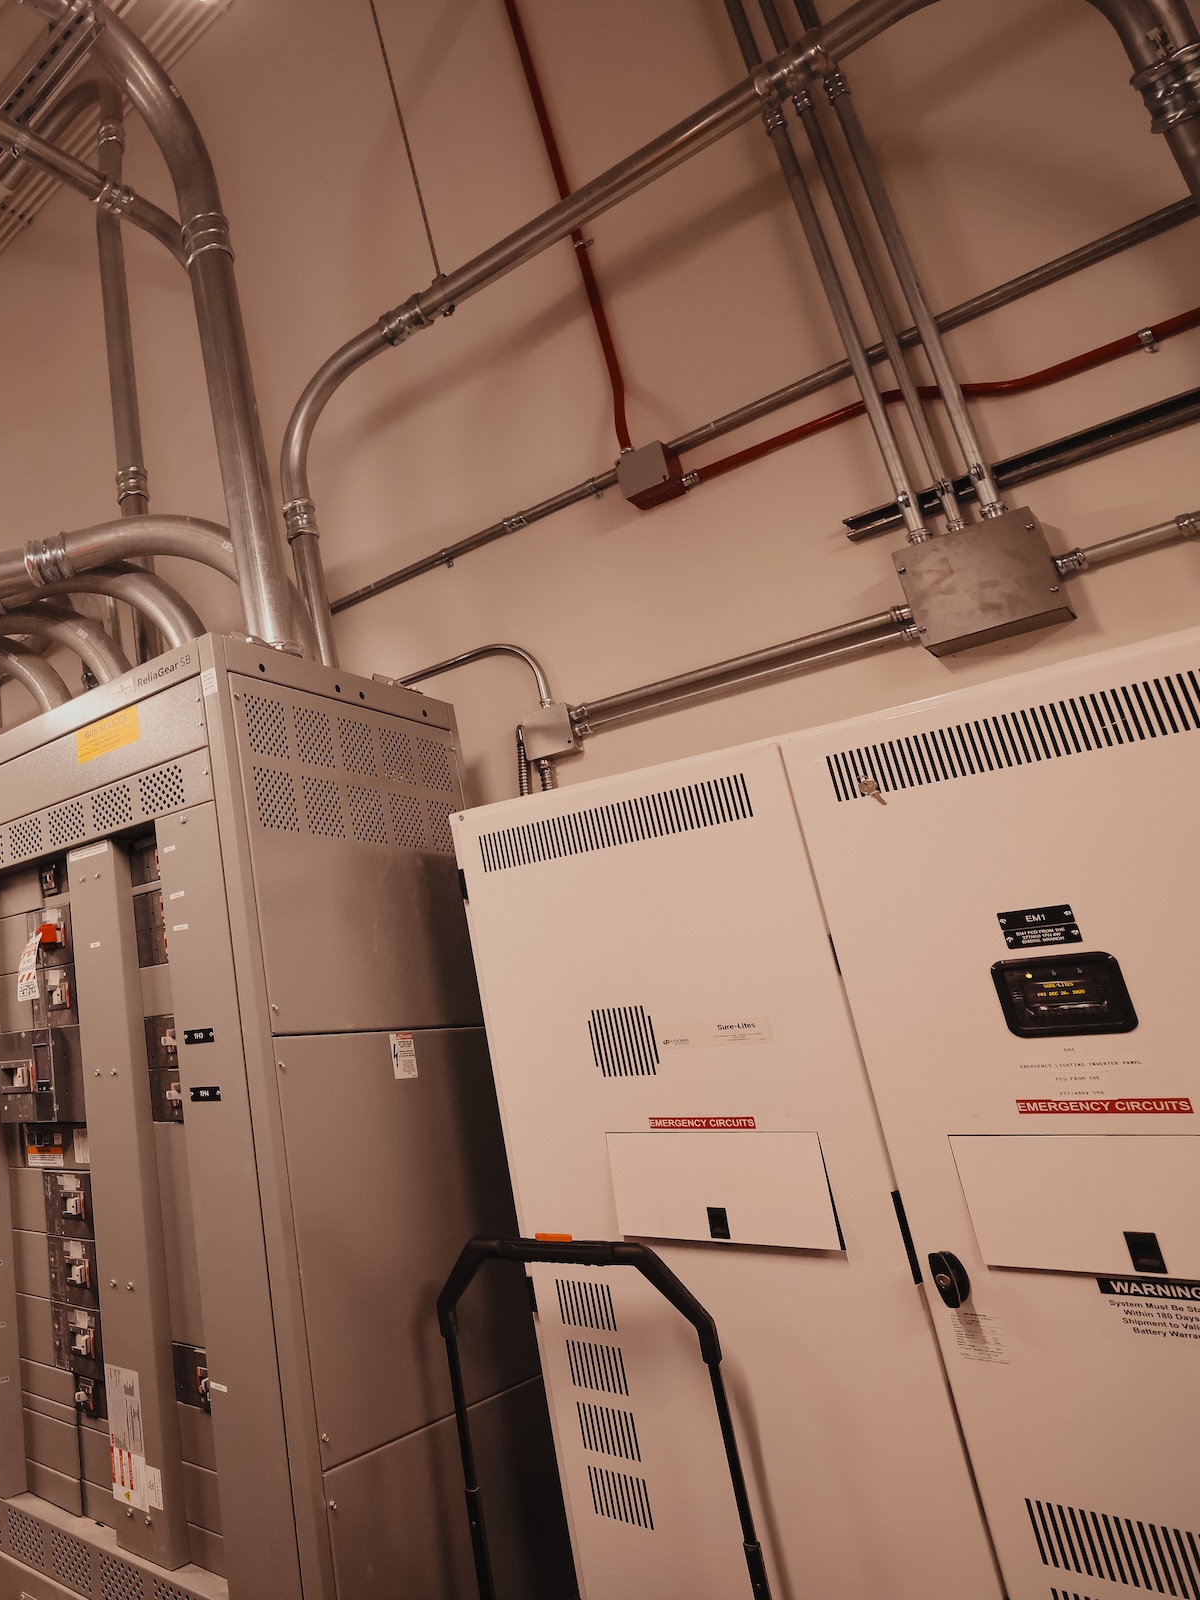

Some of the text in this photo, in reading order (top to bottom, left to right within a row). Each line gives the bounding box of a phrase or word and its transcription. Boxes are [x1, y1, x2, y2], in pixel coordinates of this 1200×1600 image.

[136, 661, 179, 687] ReliaGear
[180, 654, 192, 668] SB
[84, 713, 128, 739] BUS SPLICES
[1024, 913, 1047, 923] EM1
[717, 1022, 756, 1031] Sure-Lites
[1016, 1100, 1191, 1112] EMERGENCY CIRCUITS
[649, 1118, 755, 1127] EMERGENCY CIRCUITS
[1108, 1299, 1143, 1308] System
[1145, 1302, 1169, 1311] Must
[1170, 1304, 1185, 1312] Be
[1123, 1309, 1200, 1323] Within 180 Days
[1122, 1317, 1167, 1328] Shipment
[1169, 1321, 1180, 1329] to
[1132, 1327, 1200, 1340] Battery Warra
